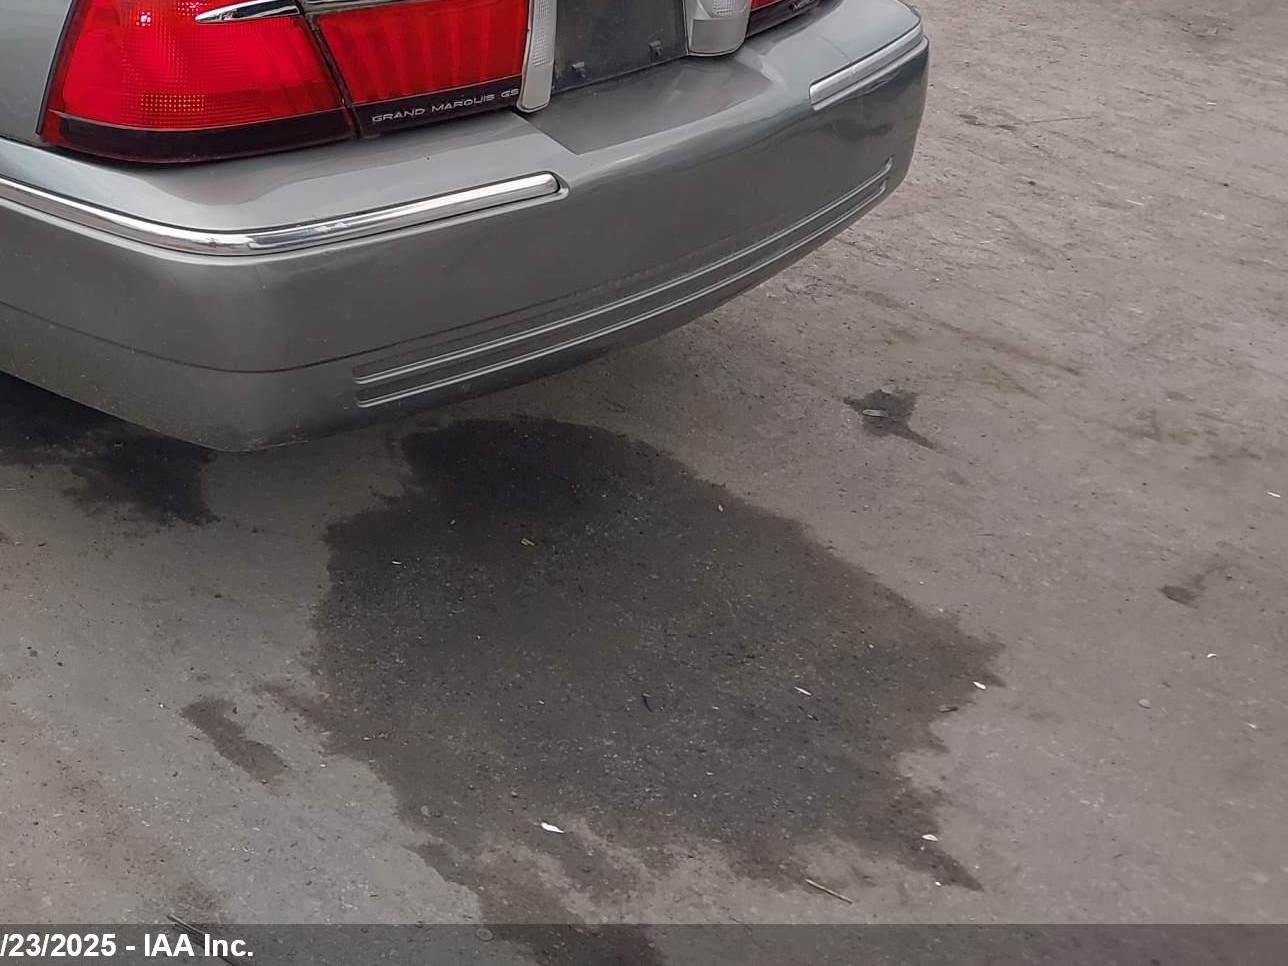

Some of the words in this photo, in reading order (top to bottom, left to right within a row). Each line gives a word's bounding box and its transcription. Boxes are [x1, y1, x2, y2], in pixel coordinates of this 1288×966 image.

[372, 108, 425, 123] GRAND
[431, 94, 496, 113] MARQUIS
[500, 88, 520, 98] GS
